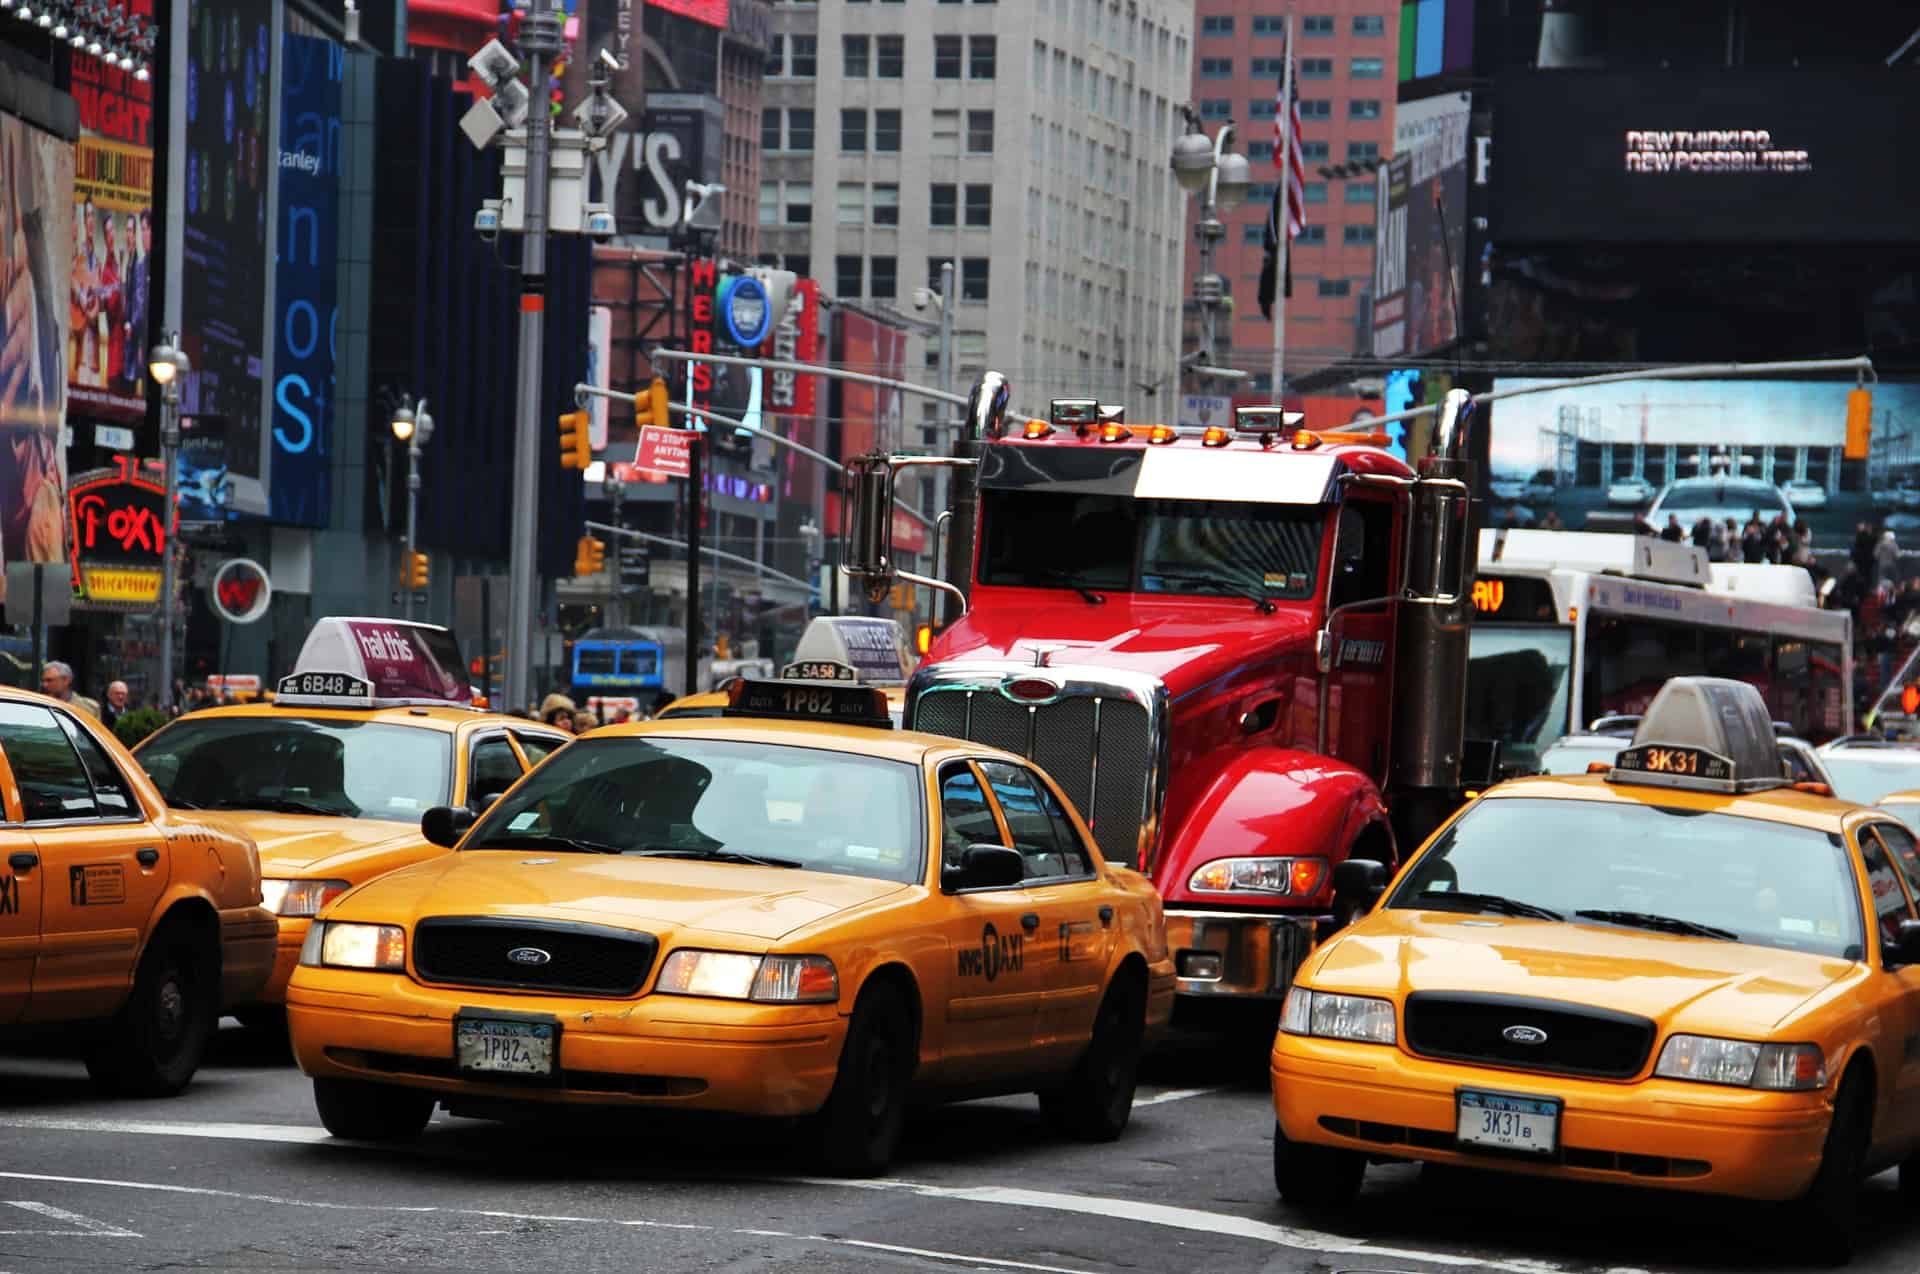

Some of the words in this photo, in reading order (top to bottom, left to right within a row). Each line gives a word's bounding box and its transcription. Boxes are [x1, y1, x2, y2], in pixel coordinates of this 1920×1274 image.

[1626, 131, 1674, 150] NEW
[1626, 151, 1674, 172] NEW
[357, 629, 389, 660] hail
[384, 631, 415, 662] this
[302, 675, 344, 694] 6B48
[783, 688, 833, 714] 1P82
[1646, 749, 1698, 775] 3K31
